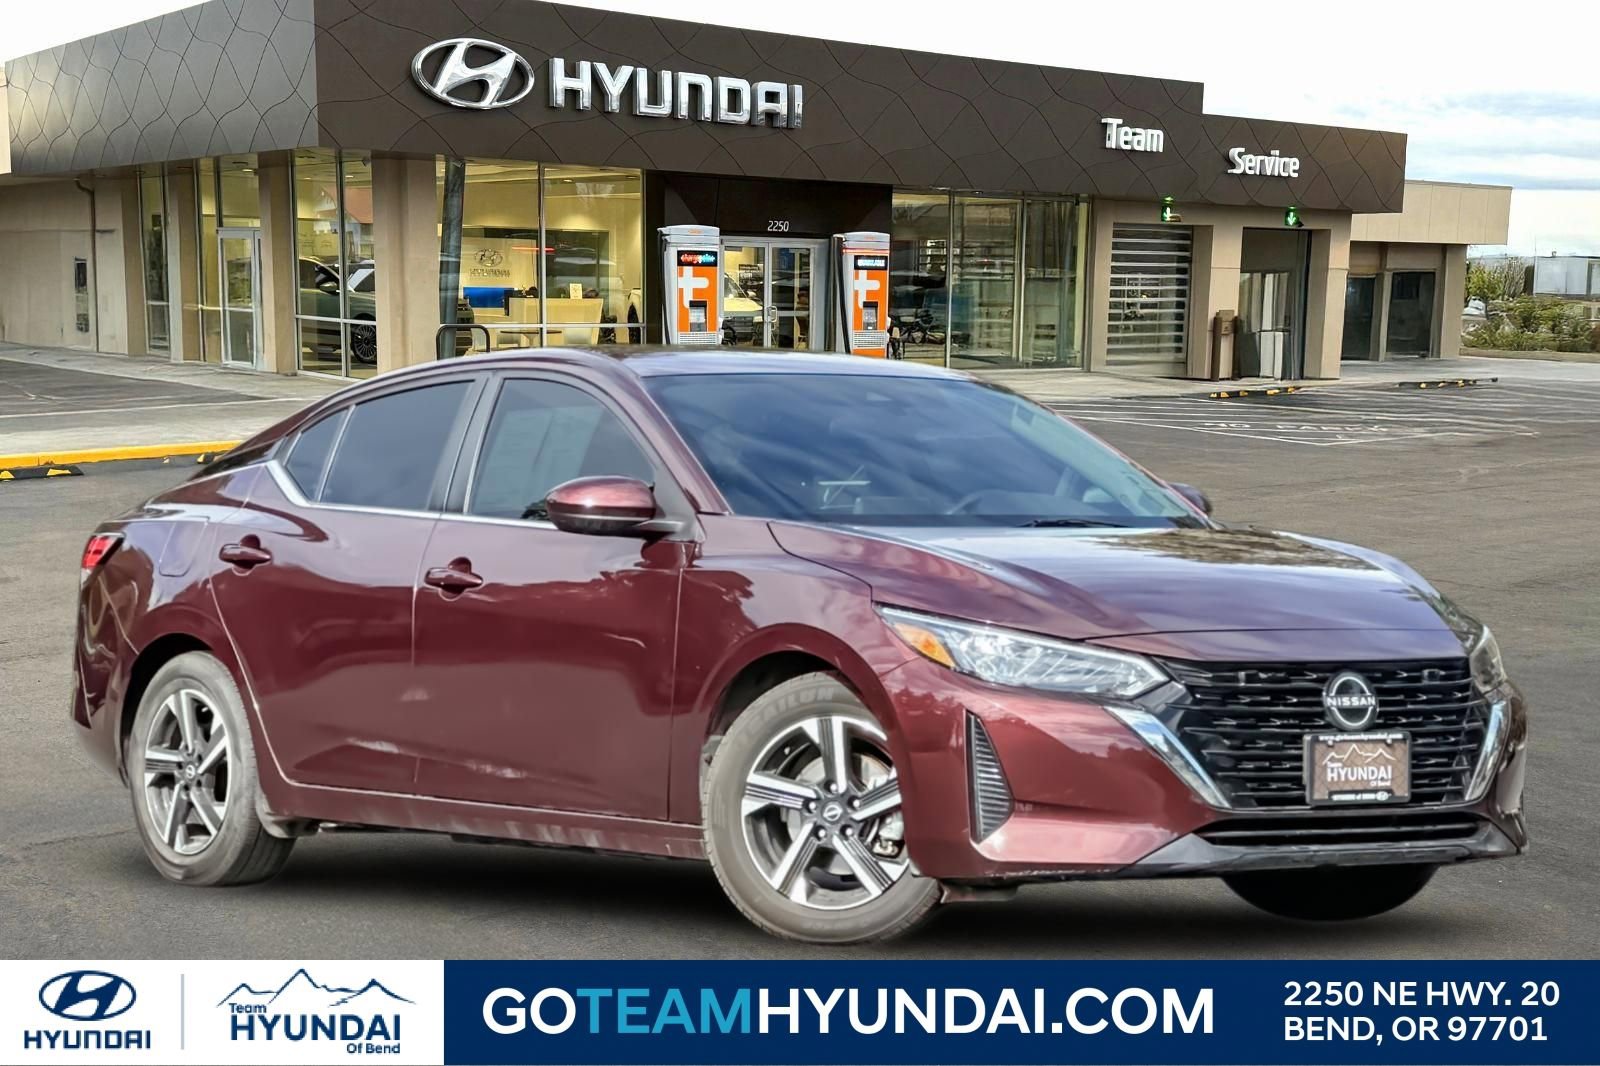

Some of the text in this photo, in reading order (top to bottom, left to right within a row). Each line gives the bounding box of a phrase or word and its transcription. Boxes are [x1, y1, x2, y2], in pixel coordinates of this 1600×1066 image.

[549, 57, 803, 128] HYUNDAI
[1101, 117, 1164, 153] Team
[1227, 147, 1300, 178] Service
[767, 220, 790, 232] 2250
[1326, 696, 1376, 706] NISSAN
[1327, 766, 1392, 782] HYUNDAI
